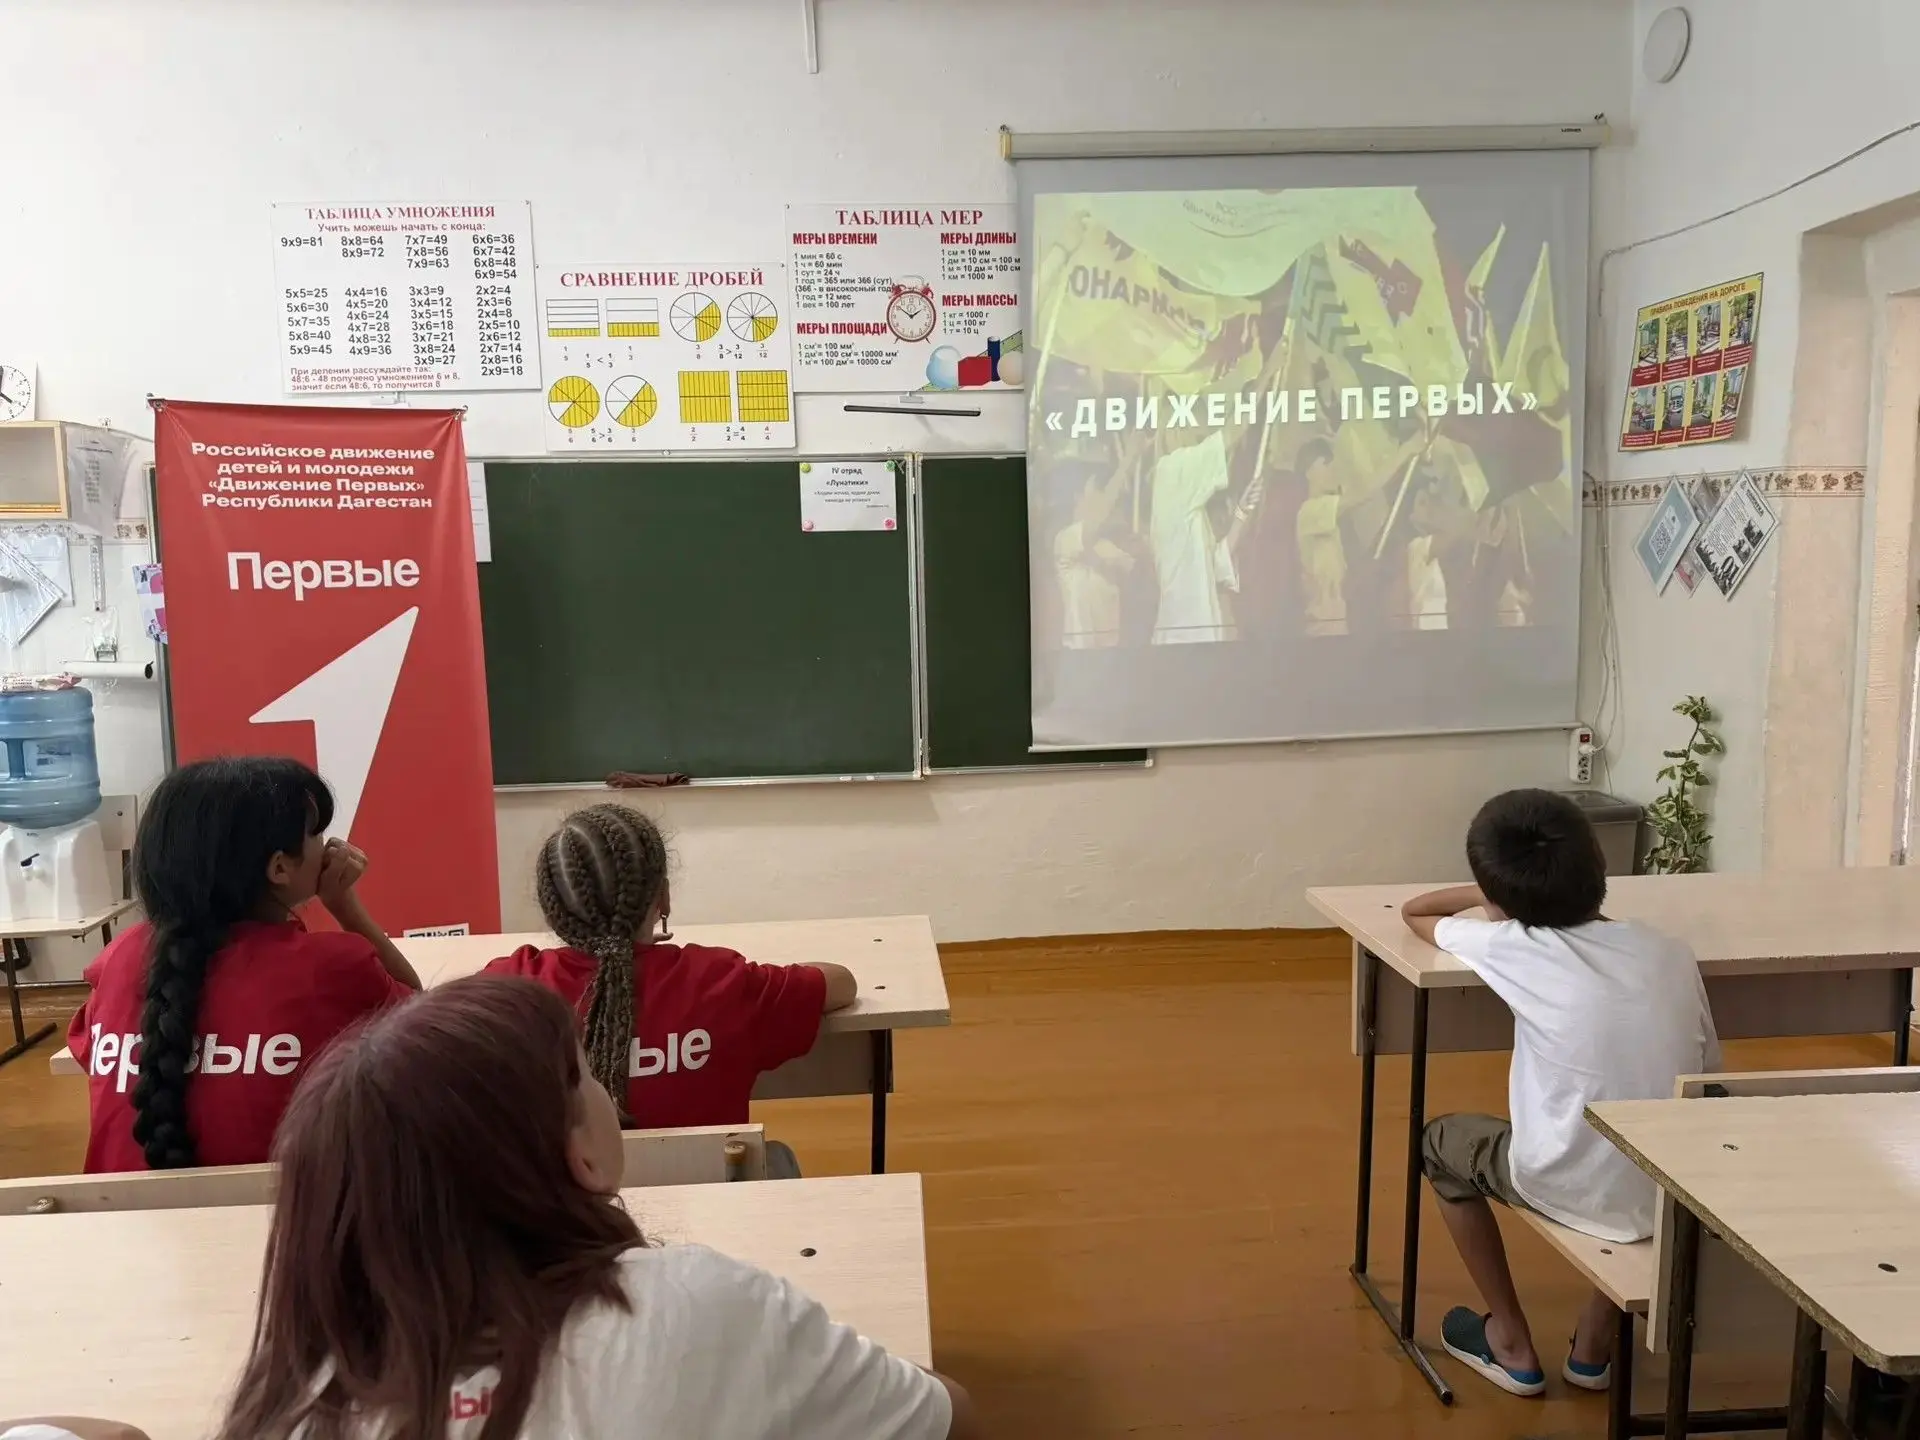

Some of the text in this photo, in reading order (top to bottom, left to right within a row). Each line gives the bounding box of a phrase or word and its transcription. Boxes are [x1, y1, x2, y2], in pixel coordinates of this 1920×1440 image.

[305, 206, 495, 220] ТАБЛИЦА УМНОЖЕНИЯ
[835, 210, 983, 227] ТАБЛИЦА МЕР
[318, 224, 350, 232] Учить
[401, 223, 438, 231] начать
[451, 223, 486, 231] конца:
[281, 237, 323, 247] 9x9=81
[341, 236, 383, 246] 8x8=64
[405, 235, 447, 245] 7x7=49
[472, 234, 514, 244] 6x6=36
[793, 233, 877, 245] МЕРЫ ВРЕМЕНИ
[940, 232, 1016, 246] МЕРЫ ДЛИНЫ
[342, 247, 384, 258] 8x9=72
[406, 247, 448, 256] 7x8=56
[473, 246, 515, 256] 6x7=42
[407, 258, 449, 268] 7x9=63
[474, 257, 516, 267] 6x8=48
[475, 269, 517, 279] 6x9=54
[974, 265, 985, 273] дм
[560, 268, 763, 289] СРАВНЕНИЕ ДРОБЕЙ
[873, 277, 892, 285] (сут)
[285, 288, 328, 298] 5x5=25
[345, 287, 387, 297] 4x4=16
[408, 286, 444, 296] 3x3=9
[476, 285, 511, 295] 2x2=4
[795, 285, 811, 293] (366
[942, 294, 1017, 307] МЕРЫ МАССЫ
[1674, 293, 1708, 309] ПОВЕДЕНИЯ
[1709, 291, 1718, 300] НА
[1720, 282, 1746, 298] ДОРОГЕ
[287, 302, 329, 312] 5x6=30
[346, 299, 388, 309] 4x5=20
[410, 297, 452, 308] 3x4=12
[477, 297, 511, 307] 2x3=6
[347, 310, 389, 321] 4x6=24
[411, 309, 453, 319] 3x5=15
[478, 308, 512, 318] 2x4=8
[288, 316, 330, 327] 5x7=35
[412, 321, 453, 331] 3x6=18
[478, 320, 520, 330] 2x5=10
[348, 322, 390, 332] 4x7=28
[797, 322, 887, 336] МЕРЫ ПЛОЩАДИ
[289, 330, 331, 341] 5x8=40
[348, 334, 391, 344] 4x8=32
[412, 332, 454, 343] 3x7=21
[479, 332, 521, 341] 2x6=12
[290, 345, 332, 355] 5x9=45
[349, 345, 392, 355] 4x9=36
[413, 344, 455, 354] 3x8=24
[480, 343, 522, 353] 2x7=14
[414, 355, 456, 366] 3x9=27
[481, 355, 522, 365] 2x8=16
[290, 368, 309, 377] При
[352, 367, 412, 375] рассуждайте
[481, 366, 523, 376] 2x9=18
[291, 375, 310, 383] 48:6
[331, 376, 375, 384] получено
[376, 374, 434, 383] умножением
[385, 382, 433, 390] получится
[436, 380, 440, 388] 8
[1046, 380, 1539, 439] «ДВИЖЕНИЕ ПЕРВЫХ»
[191, 442, 435, 461] Российское движение
[217, 460, 415, 477] детей и молодежи
[209, 477, 425, 493] «Движение Первых»
[826, 479, 868, 487] «Лунатики»
[201, 493, 433, 511] Республики Дагестан
[227, 552, 420, 601] Первые
